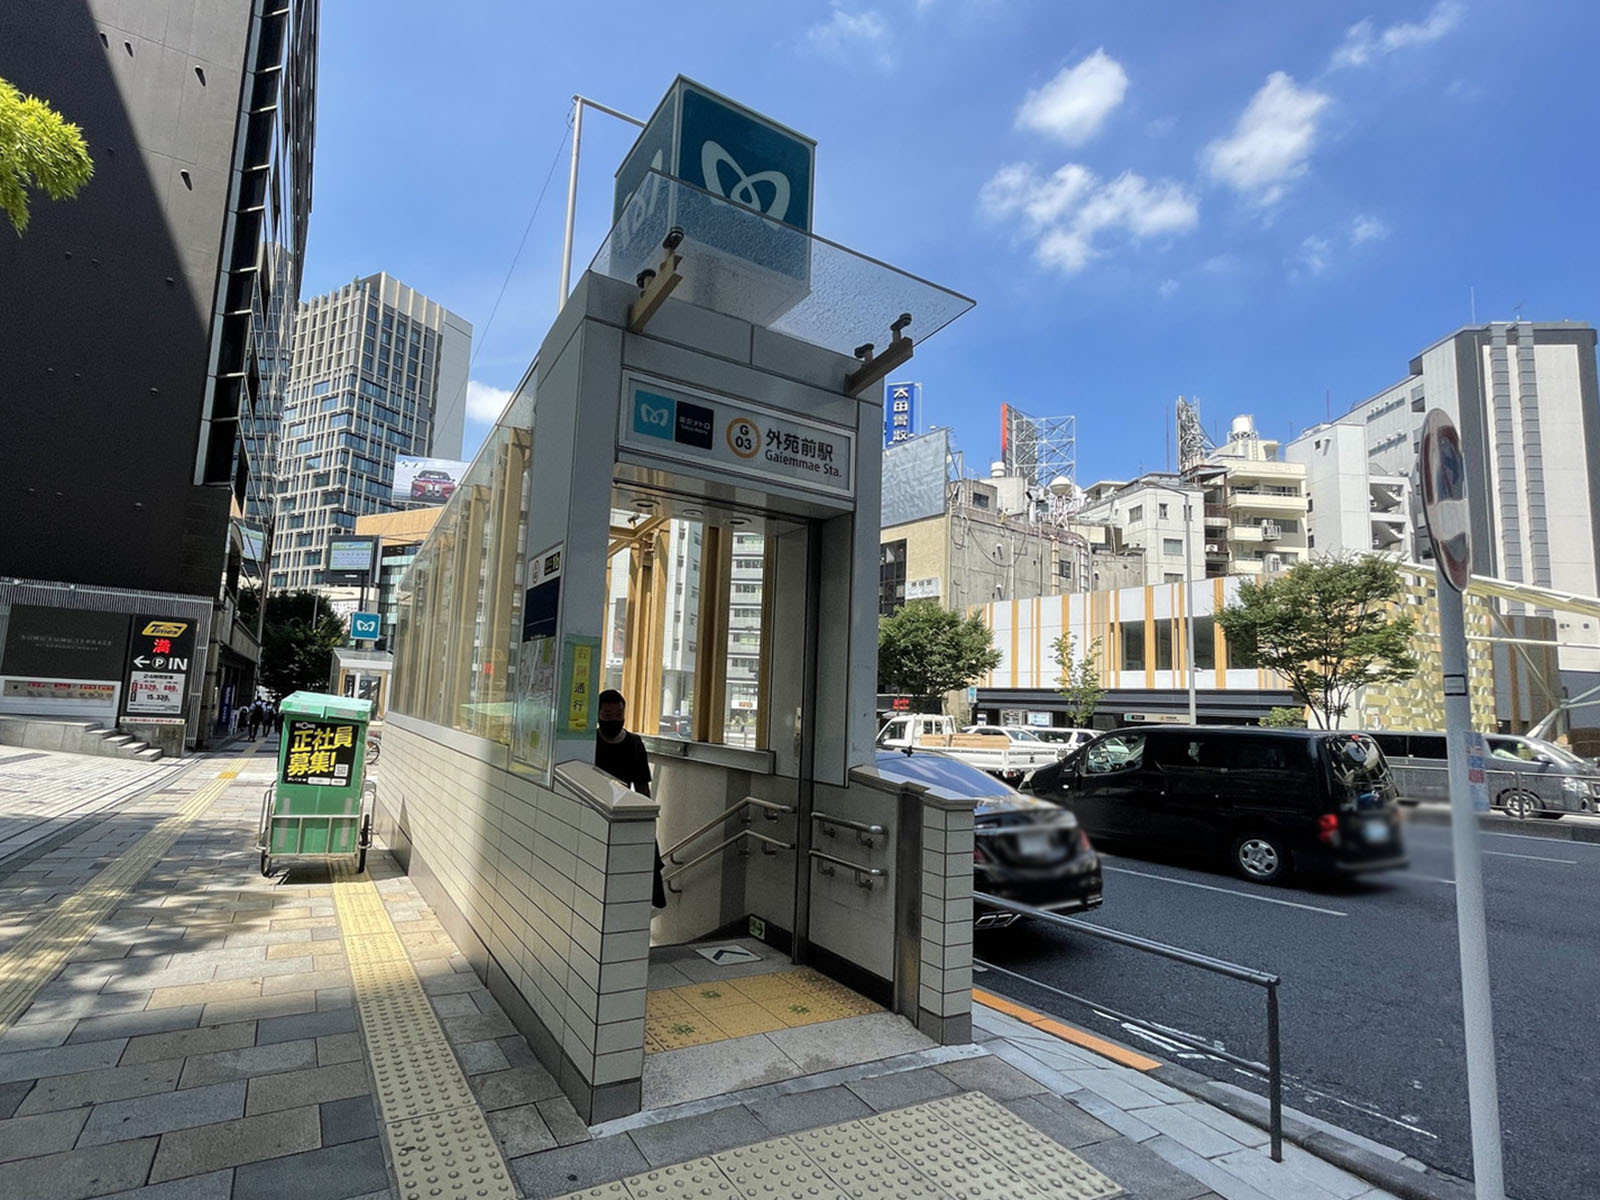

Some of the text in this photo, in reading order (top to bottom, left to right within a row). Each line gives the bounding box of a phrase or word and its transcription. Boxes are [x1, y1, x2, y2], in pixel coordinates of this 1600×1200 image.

[739, 424, 750, 436] G
[735, 436, 752, 450] 03
[765, 428, 833, 462] 外苑前駅
[765, 449, 842, 478] Gaiemmae Sta.
[168, 657, 188, 670] IN
[291, 725, 353, 752] 正社員
[287, 751, 337, 776] 募集!
